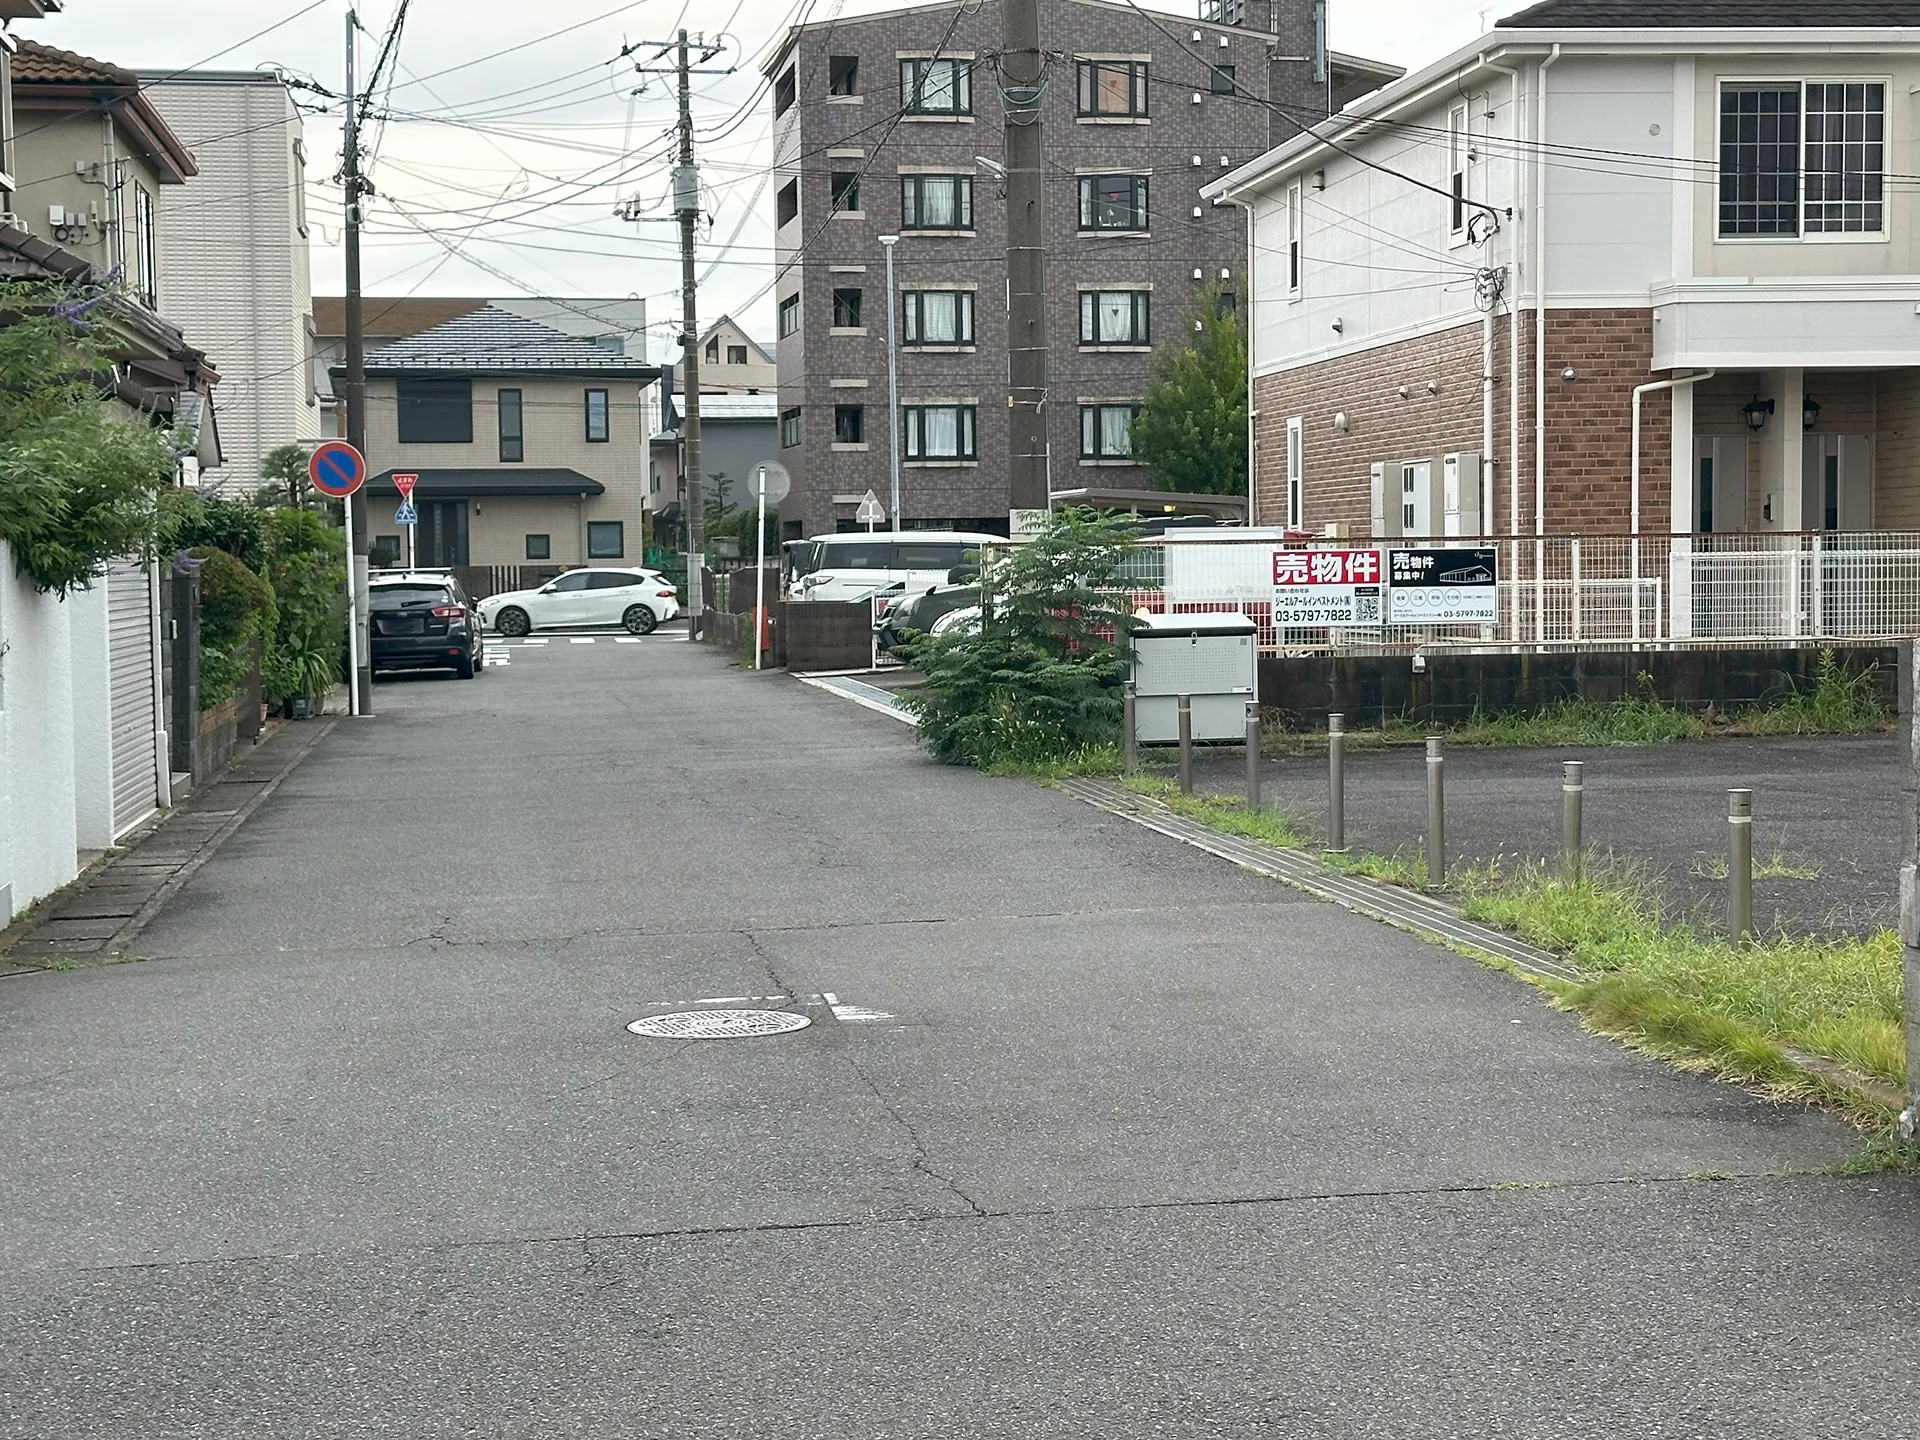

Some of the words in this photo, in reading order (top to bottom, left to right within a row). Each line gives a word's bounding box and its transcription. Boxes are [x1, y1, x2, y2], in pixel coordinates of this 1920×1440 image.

[1275, 553, 1378, 584] 売物件
[1393, 552, 1435, 570] 売物件
[1275, 609, 1352, 622] 03-5797-7822
[1443, 610, 1494, 618] 03-5797-7822
